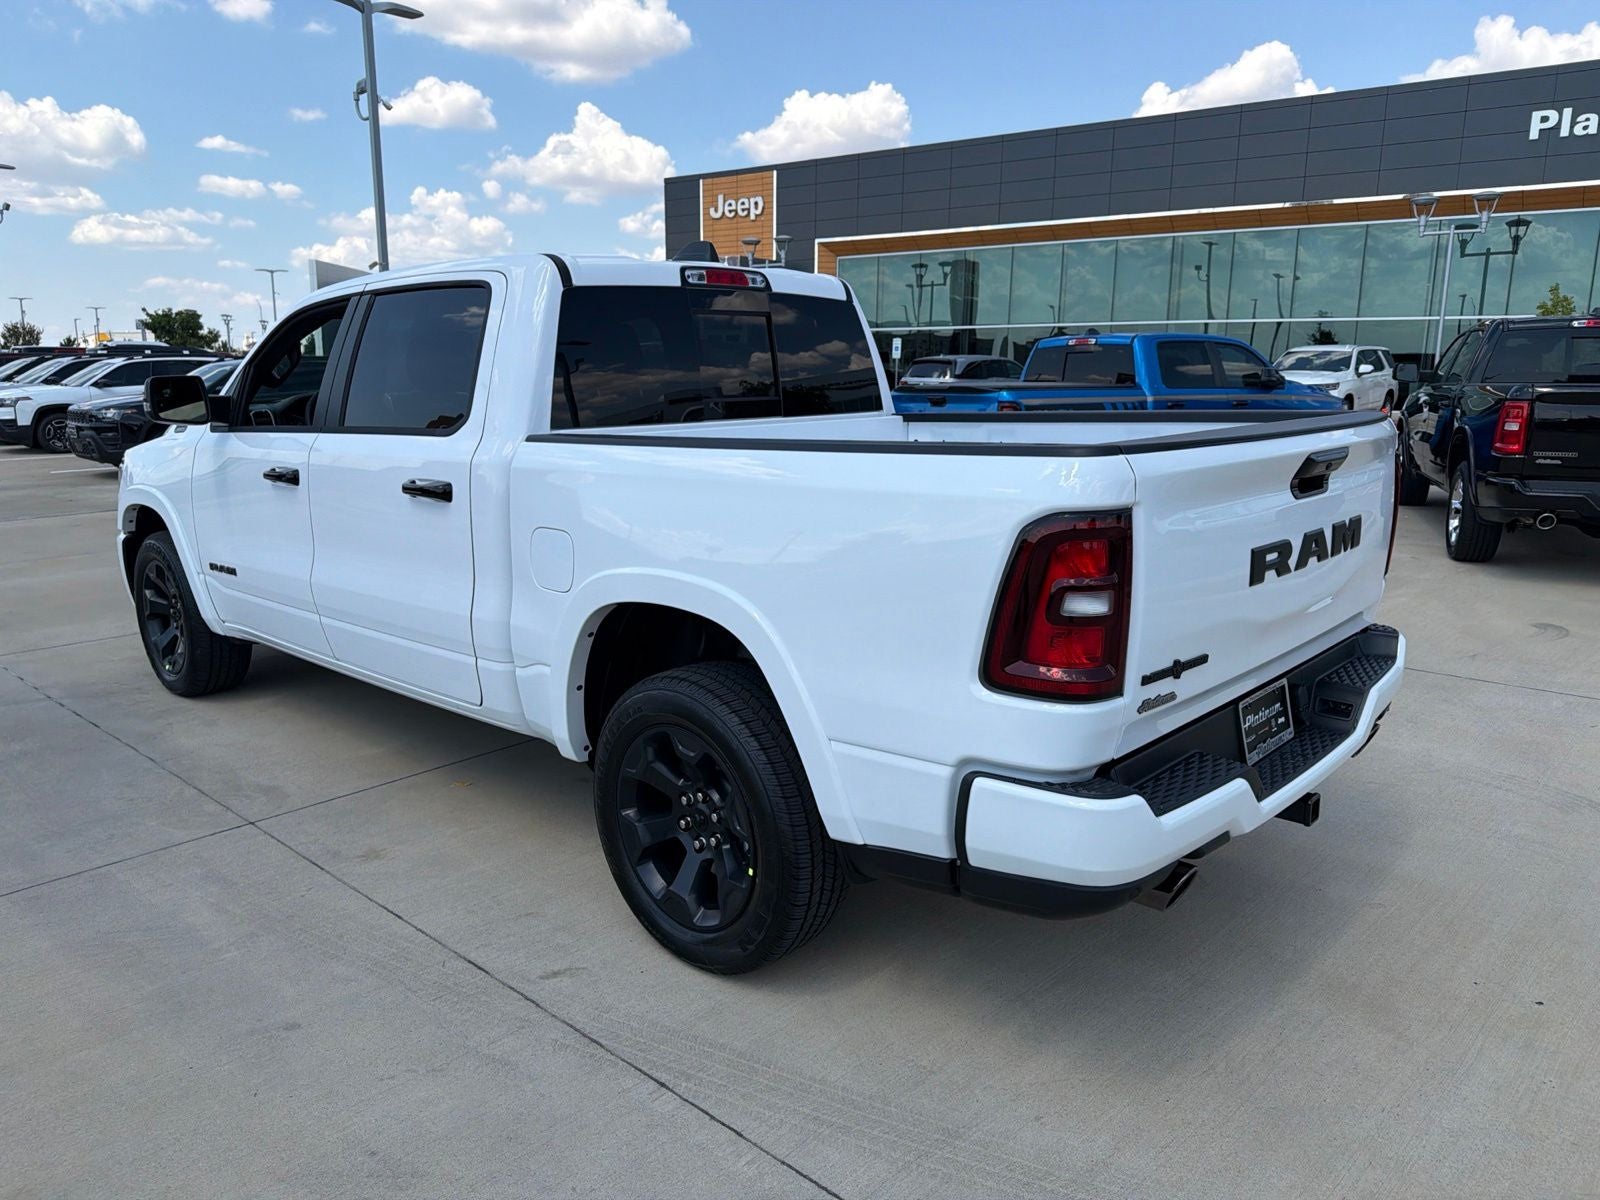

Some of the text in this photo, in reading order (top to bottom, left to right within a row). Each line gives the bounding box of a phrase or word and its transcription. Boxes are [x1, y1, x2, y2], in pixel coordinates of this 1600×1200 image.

[1529, 107, 1599, 140] Pla
[709, 193, 764, 220] Jeep
[1249, 514, 1362, 587] RAM
[1243, 702, 1283, 730] Platinum
